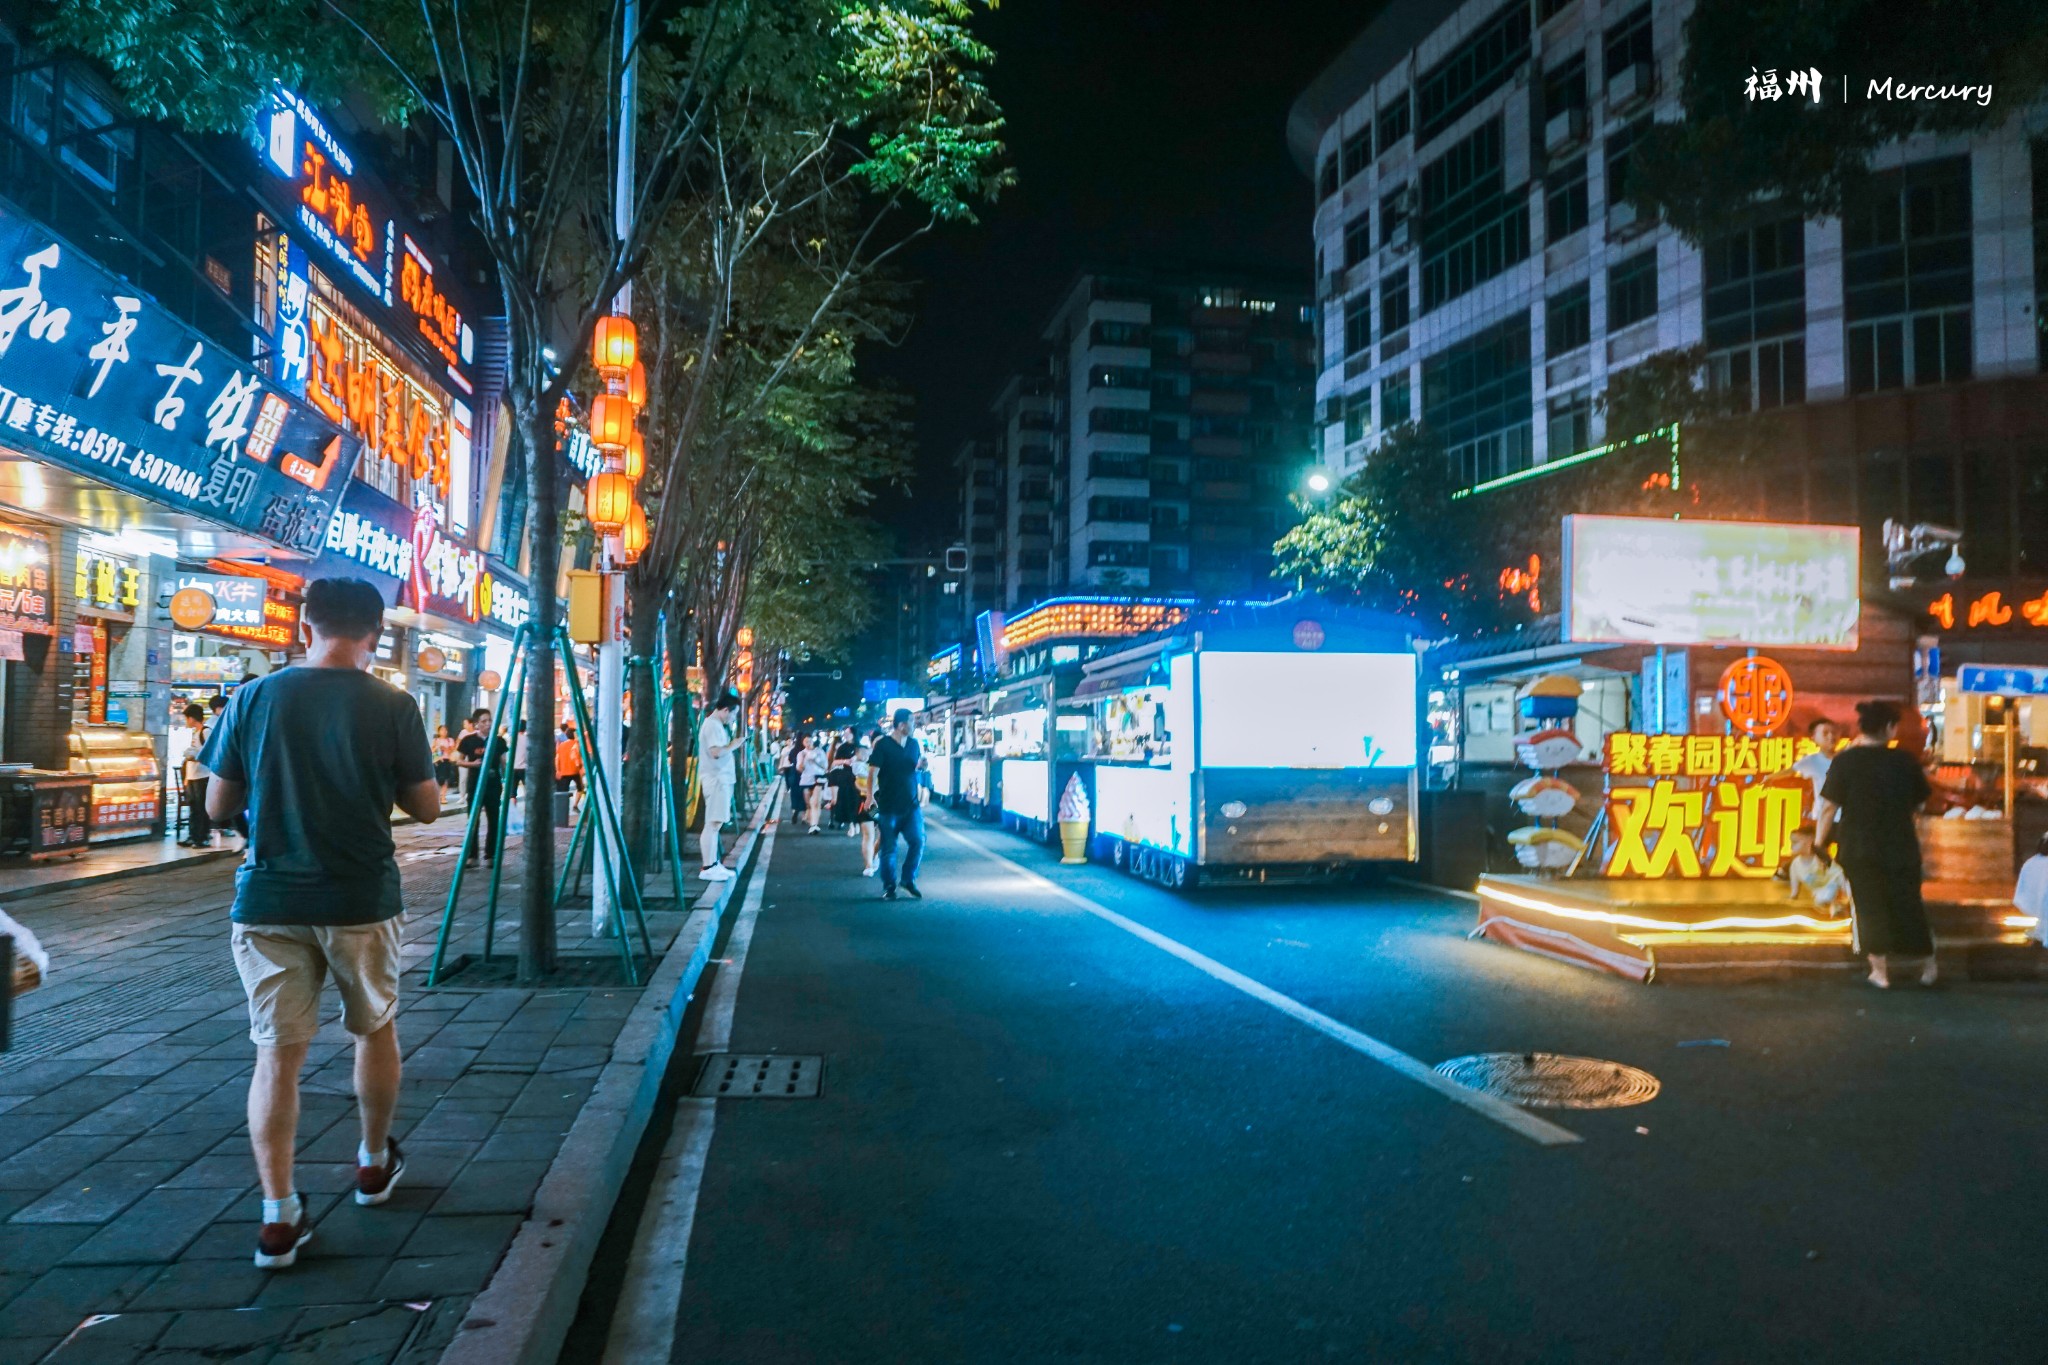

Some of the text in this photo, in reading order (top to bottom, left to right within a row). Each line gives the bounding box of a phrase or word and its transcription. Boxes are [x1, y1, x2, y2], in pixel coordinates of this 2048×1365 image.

[199, 453, 257, 514] 复印
[326, 505, 413, 582] 自助牛肉火锅
[1610, 733, 1850, 775] 聚春园达明
[1606, 779, 1803, 878] 欢迎
